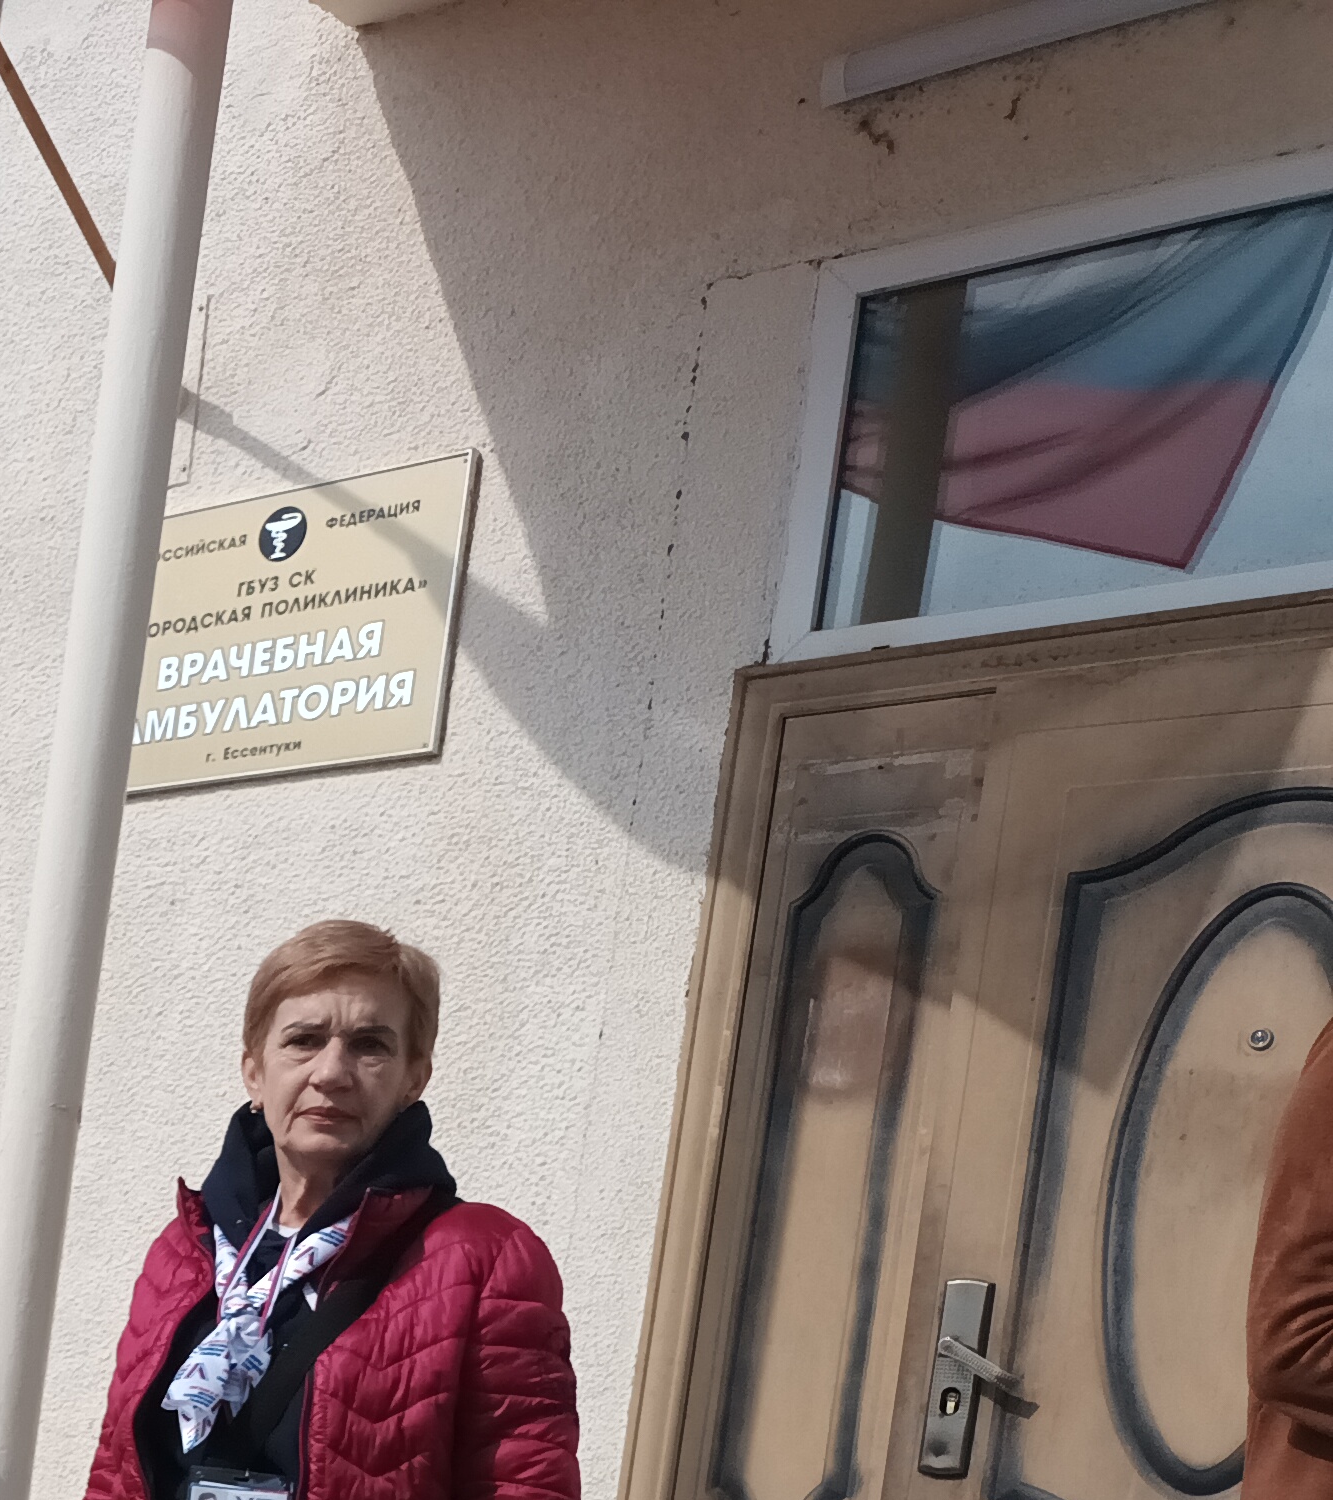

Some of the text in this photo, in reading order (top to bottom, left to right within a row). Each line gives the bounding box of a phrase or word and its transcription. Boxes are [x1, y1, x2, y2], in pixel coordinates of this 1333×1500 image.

[157, 499, 421, 562] ССИЙСКАЯ ФЕДЕРАЦИЯ
[148, 577, 428, 638] ОРОДСКАЯ ПОЛИКЛИНИКА»
[237, 568, 317, 597] ГБУЗ СК
[156, 620, 384, 691] ВРАЧЕБНАЯ
[205, 739, 302, 763] г. Ессентуки
